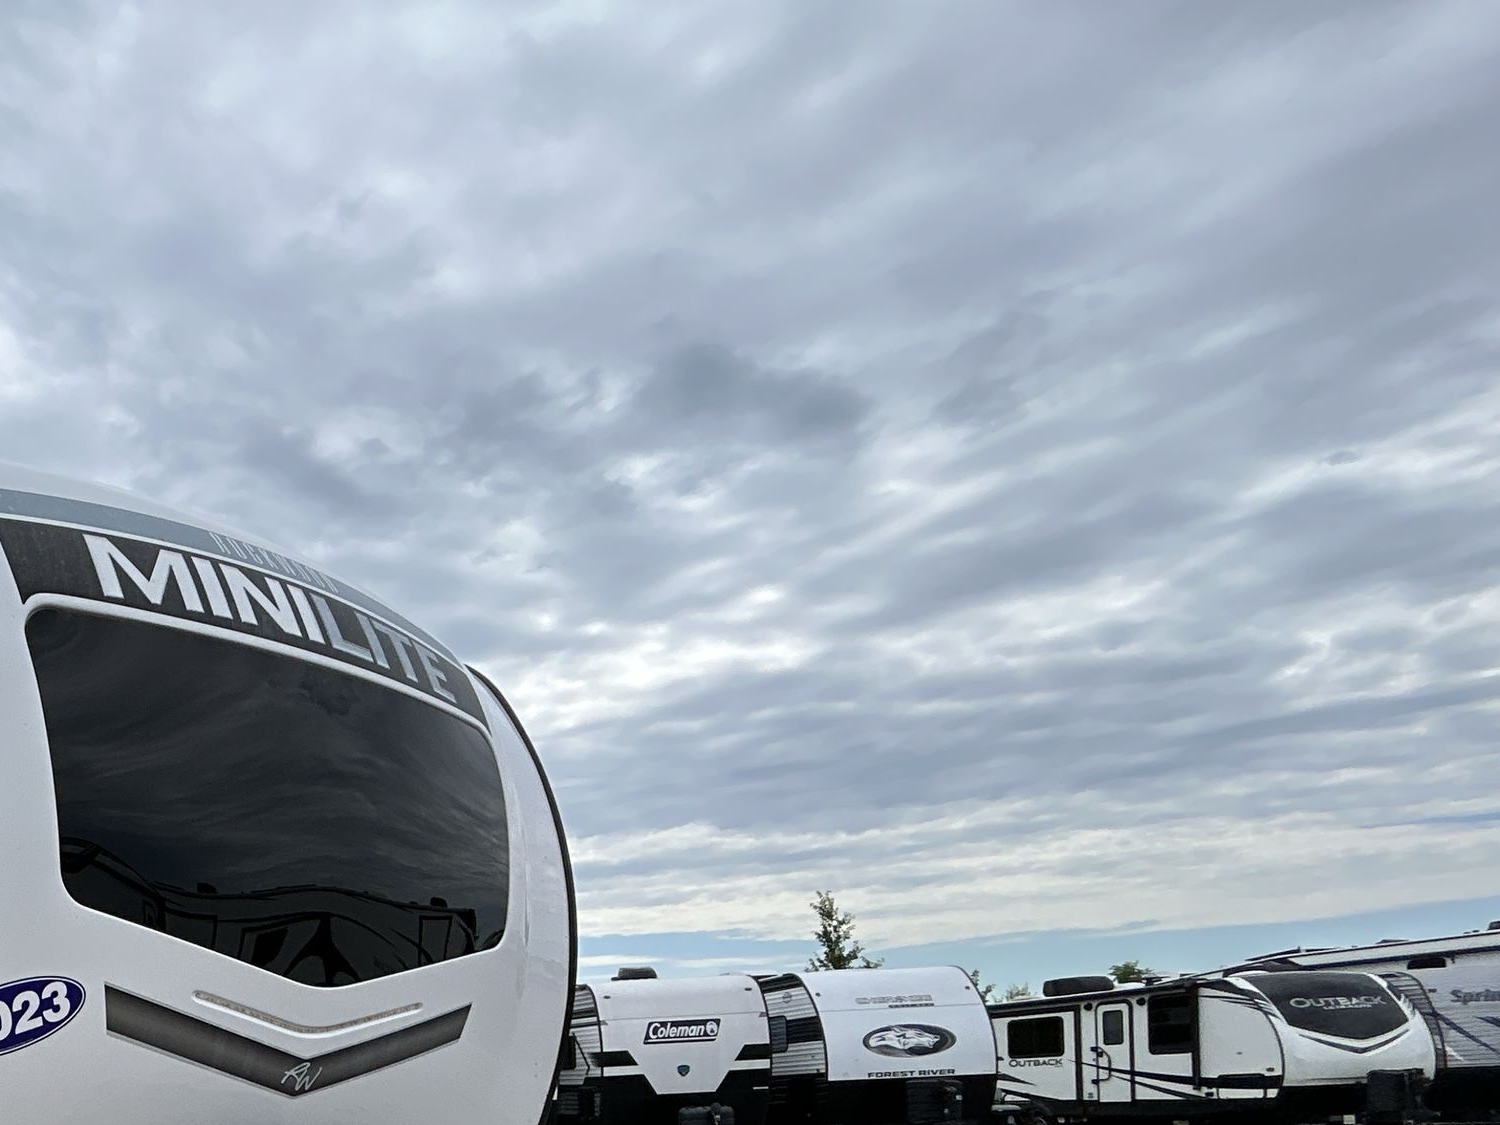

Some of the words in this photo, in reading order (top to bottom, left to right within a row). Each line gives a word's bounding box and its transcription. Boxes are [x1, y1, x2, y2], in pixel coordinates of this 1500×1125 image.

[1289, 995, 1388, 1009] OUTBACK
[648, 1022, 705, 1040] Coleman
[1008, 1058, 1063, 1068] OUTBACK
[867, 1070, 916, 1079] FOREST
[918, 1068, 956, 1076] RIVER
